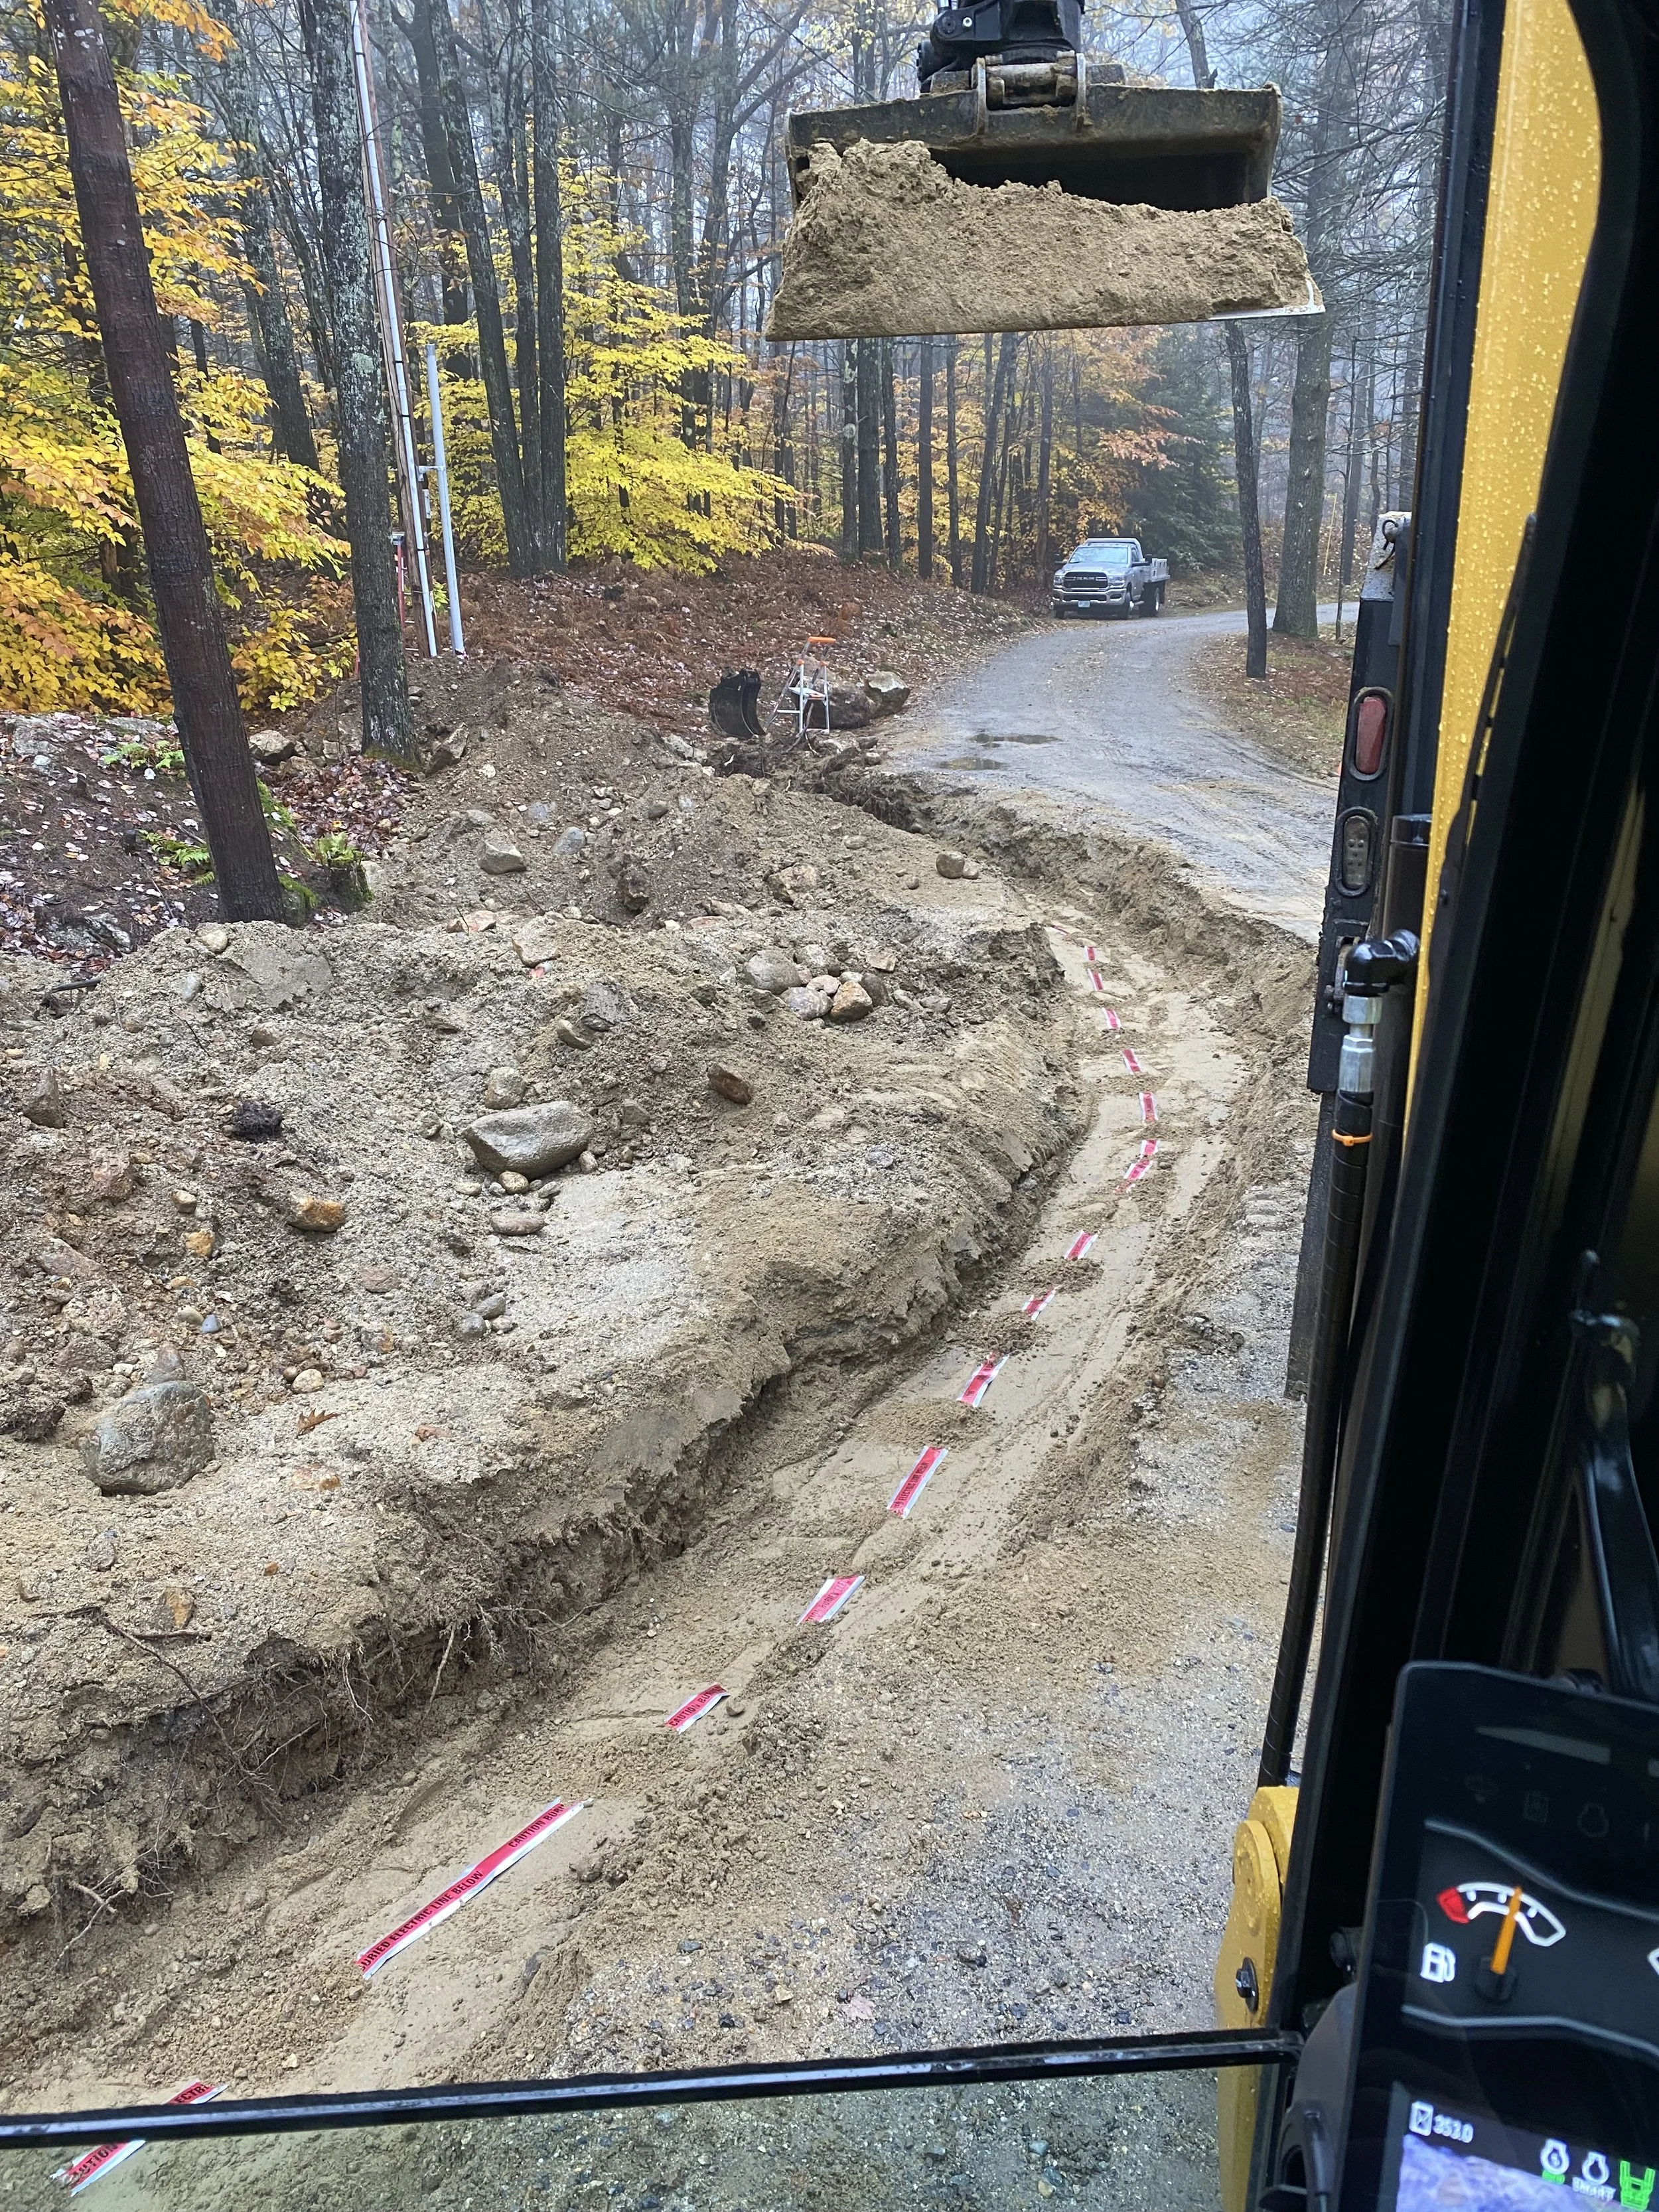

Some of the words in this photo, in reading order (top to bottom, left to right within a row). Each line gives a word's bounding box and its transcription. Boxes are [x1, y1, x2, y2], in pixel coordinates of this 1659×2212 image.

[669, 1703, 701, 1726] CAUTION
[390, 1909, 433, 1941] ELECTRIC
[430, 1893, 455, 1909] LINE
[451, 1870, 484, 1894] BELOW
[508, 1820, 546, 1848] CAUTION
[543, 1804, 565, 1821] BURI
[174, 2083, 210, 2104] ECTRI
